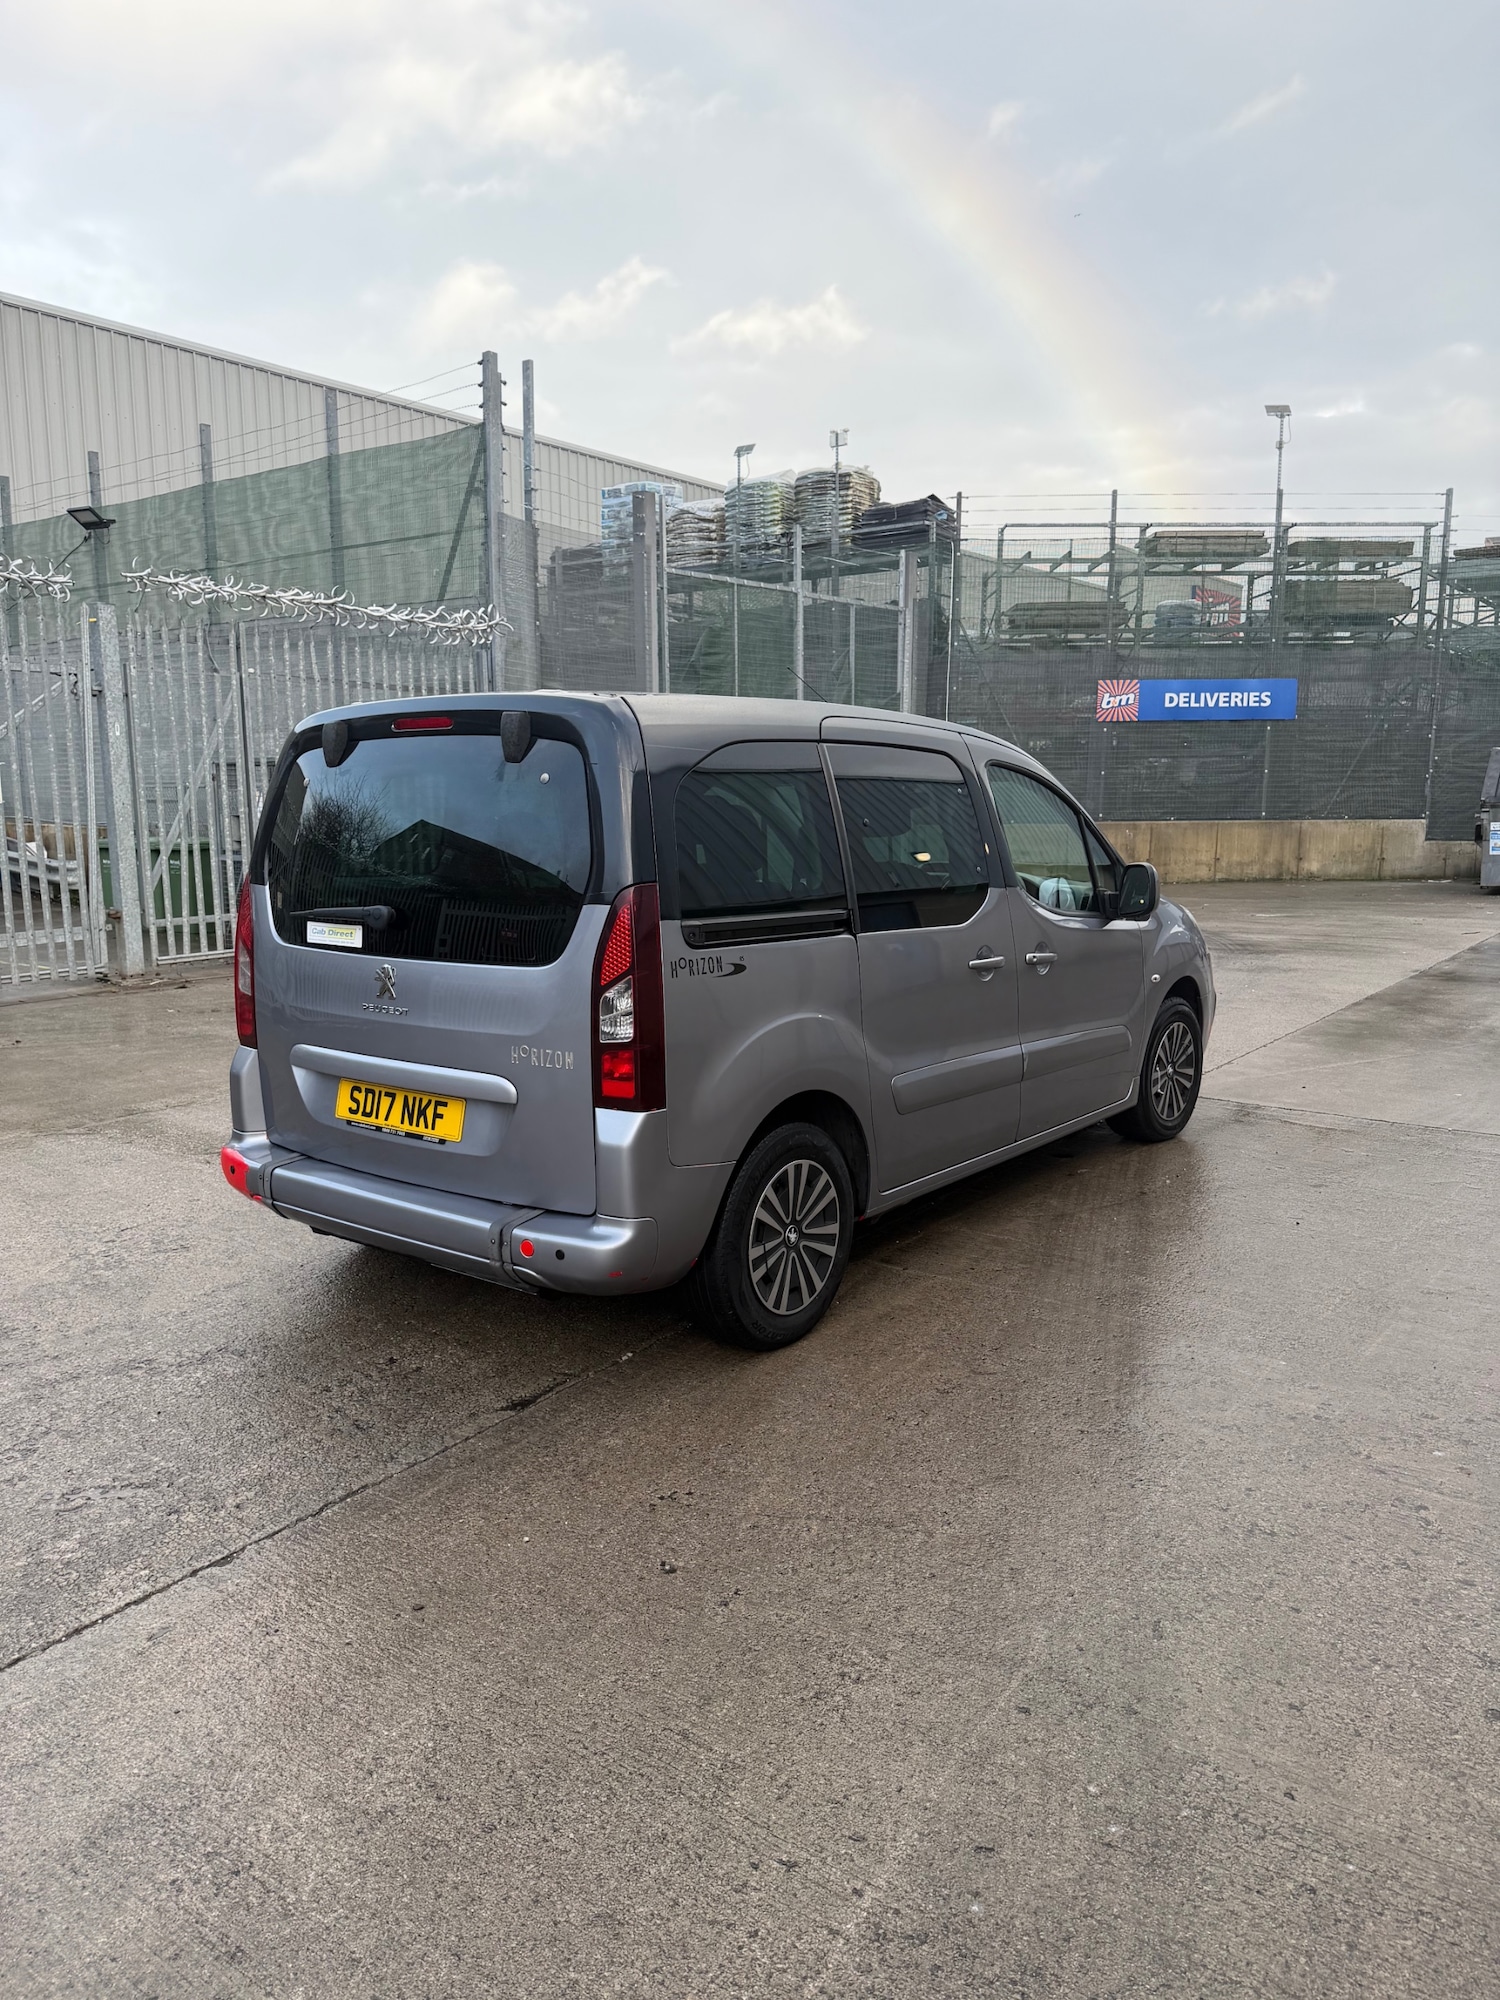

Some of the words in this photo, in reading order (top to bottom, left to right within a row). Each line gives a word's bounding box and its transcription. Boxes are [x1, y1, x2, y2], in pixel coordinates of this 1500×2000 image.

[1164, 691, 1272, 708] DELIVERIES
[311, 927, 326, 936] Cab
[327, 928, 354, 938] Direct
[362, 1002, 409, 1016] PEUGEOT
[347, 1085, 397, 1121] SD17
[400, 1094, 448, 1131] NKF
